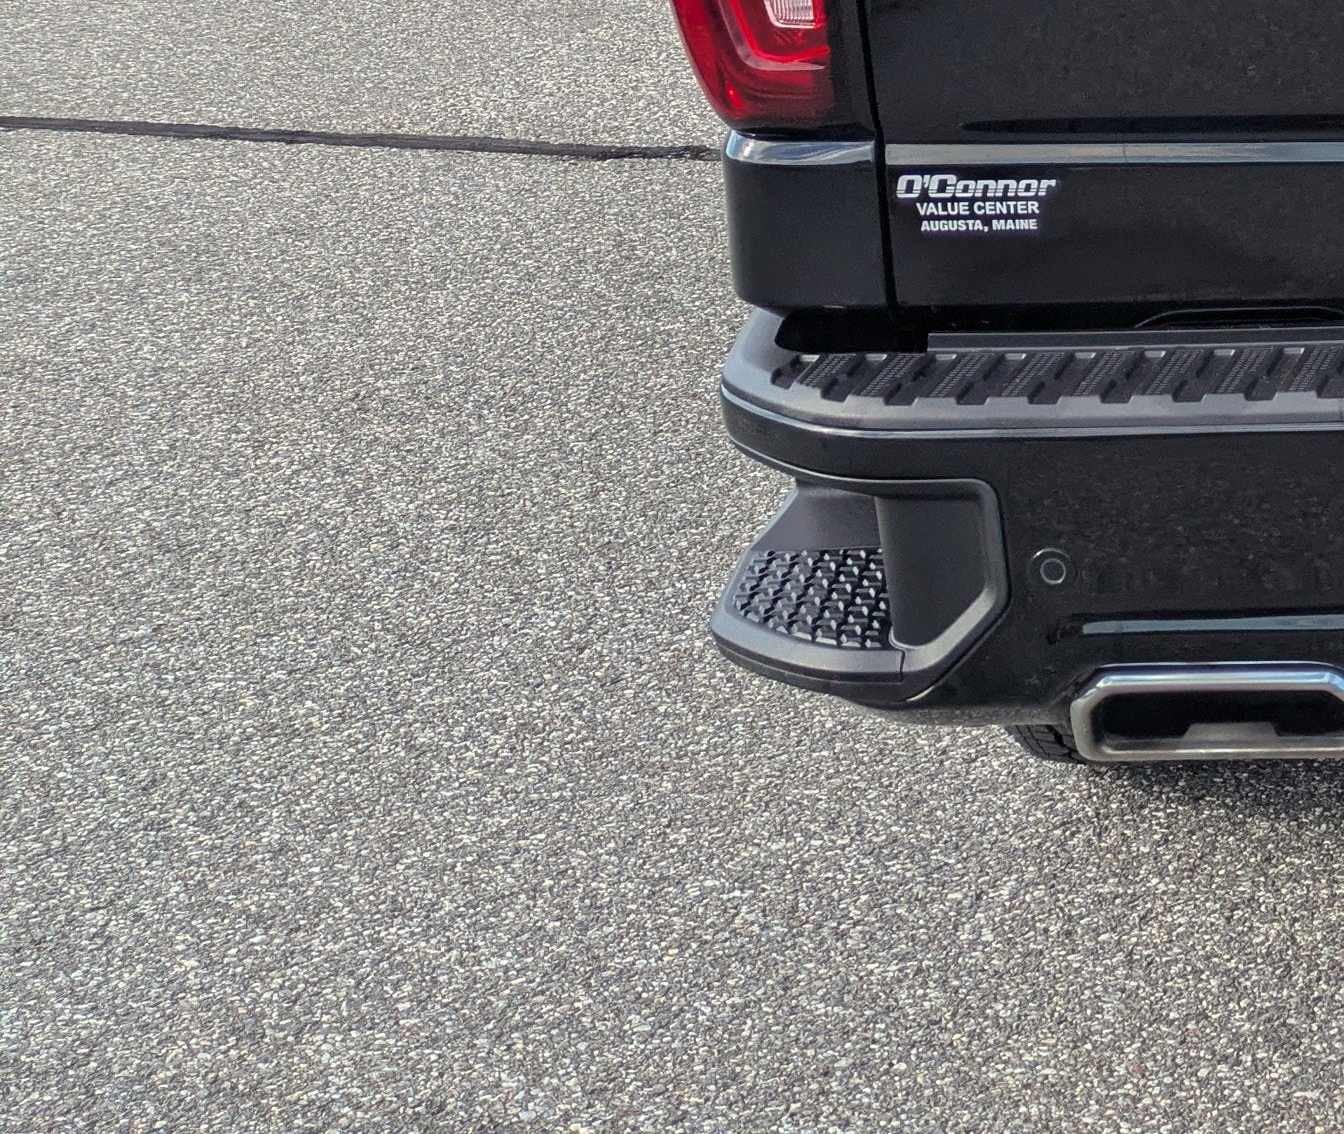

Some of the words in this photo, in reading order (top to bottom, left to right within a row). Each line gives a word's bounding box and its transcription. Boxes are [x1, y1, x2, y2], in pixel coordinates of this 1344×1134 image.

[896, 174, 1056, 198] O'Connor
[916, 202, 970, 216] VALUE
[973, 201, 1040, 215] CENTER
[920, 220, 989, 233] AUGUSTA,
[992, 219, 1038, 231] MAINE
